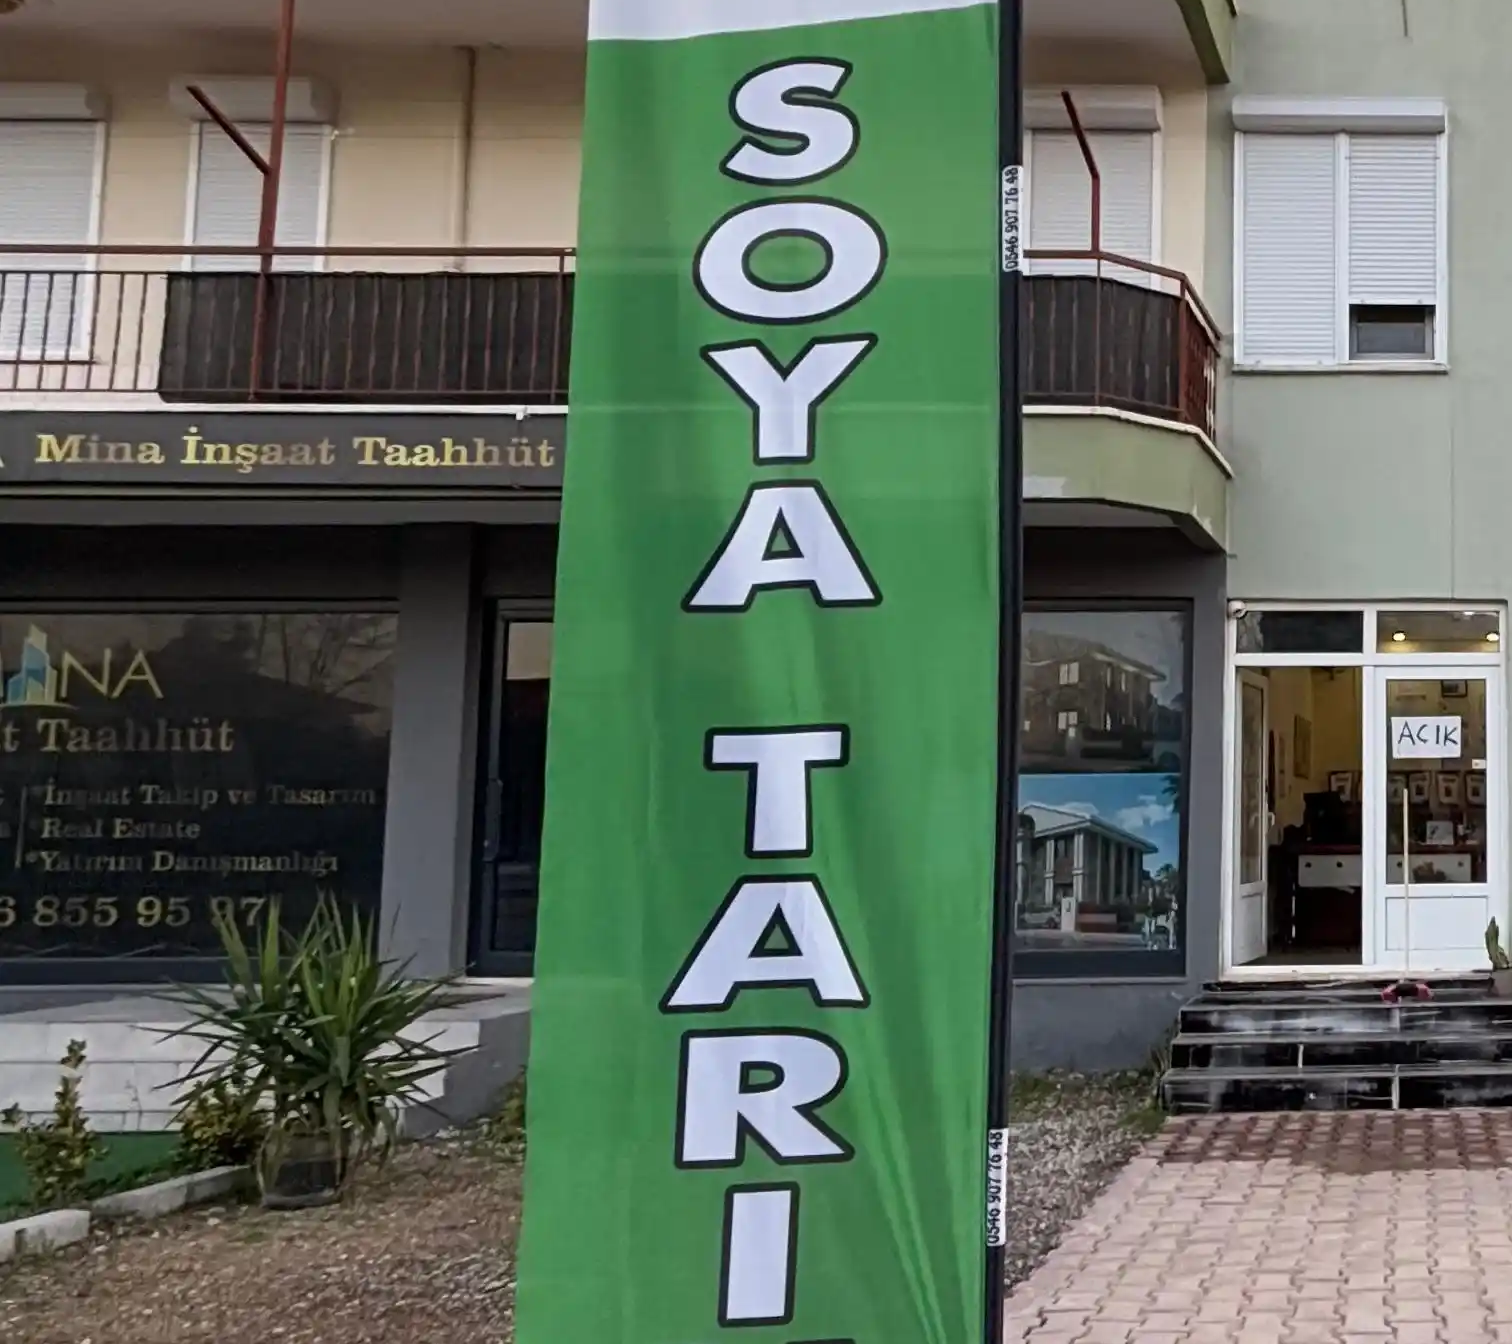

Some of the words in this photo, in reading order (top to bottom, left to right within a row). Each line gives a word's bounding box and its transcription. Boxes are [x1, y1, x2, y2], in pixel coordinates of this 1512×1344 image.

[1004, 167, 1019, 184] 48
[1004, 187, 1019, 205] 76
[1004, 209, 1019, 234] 907
[1004, 236, 1019, 270] 0546
[681, 56, 888, 613] SOYA
[35, 433, 165, 464] Mina
[180, 425, 336, 474] İnşaat
[352, 436, 555, 468] Taahhüt
[36, 717, 235, 753] Taahhüt
[227, 789, 256, 805] ve
[40, 817, 104, 839] Real
[112, 817, 201, 839] Estate
[33, 895, 119, 928] 855
[136, 895, 191, 928] 95
[988, 1178, 1002, 1203] 907
[987, 1208, 1001, 1244] 0546
